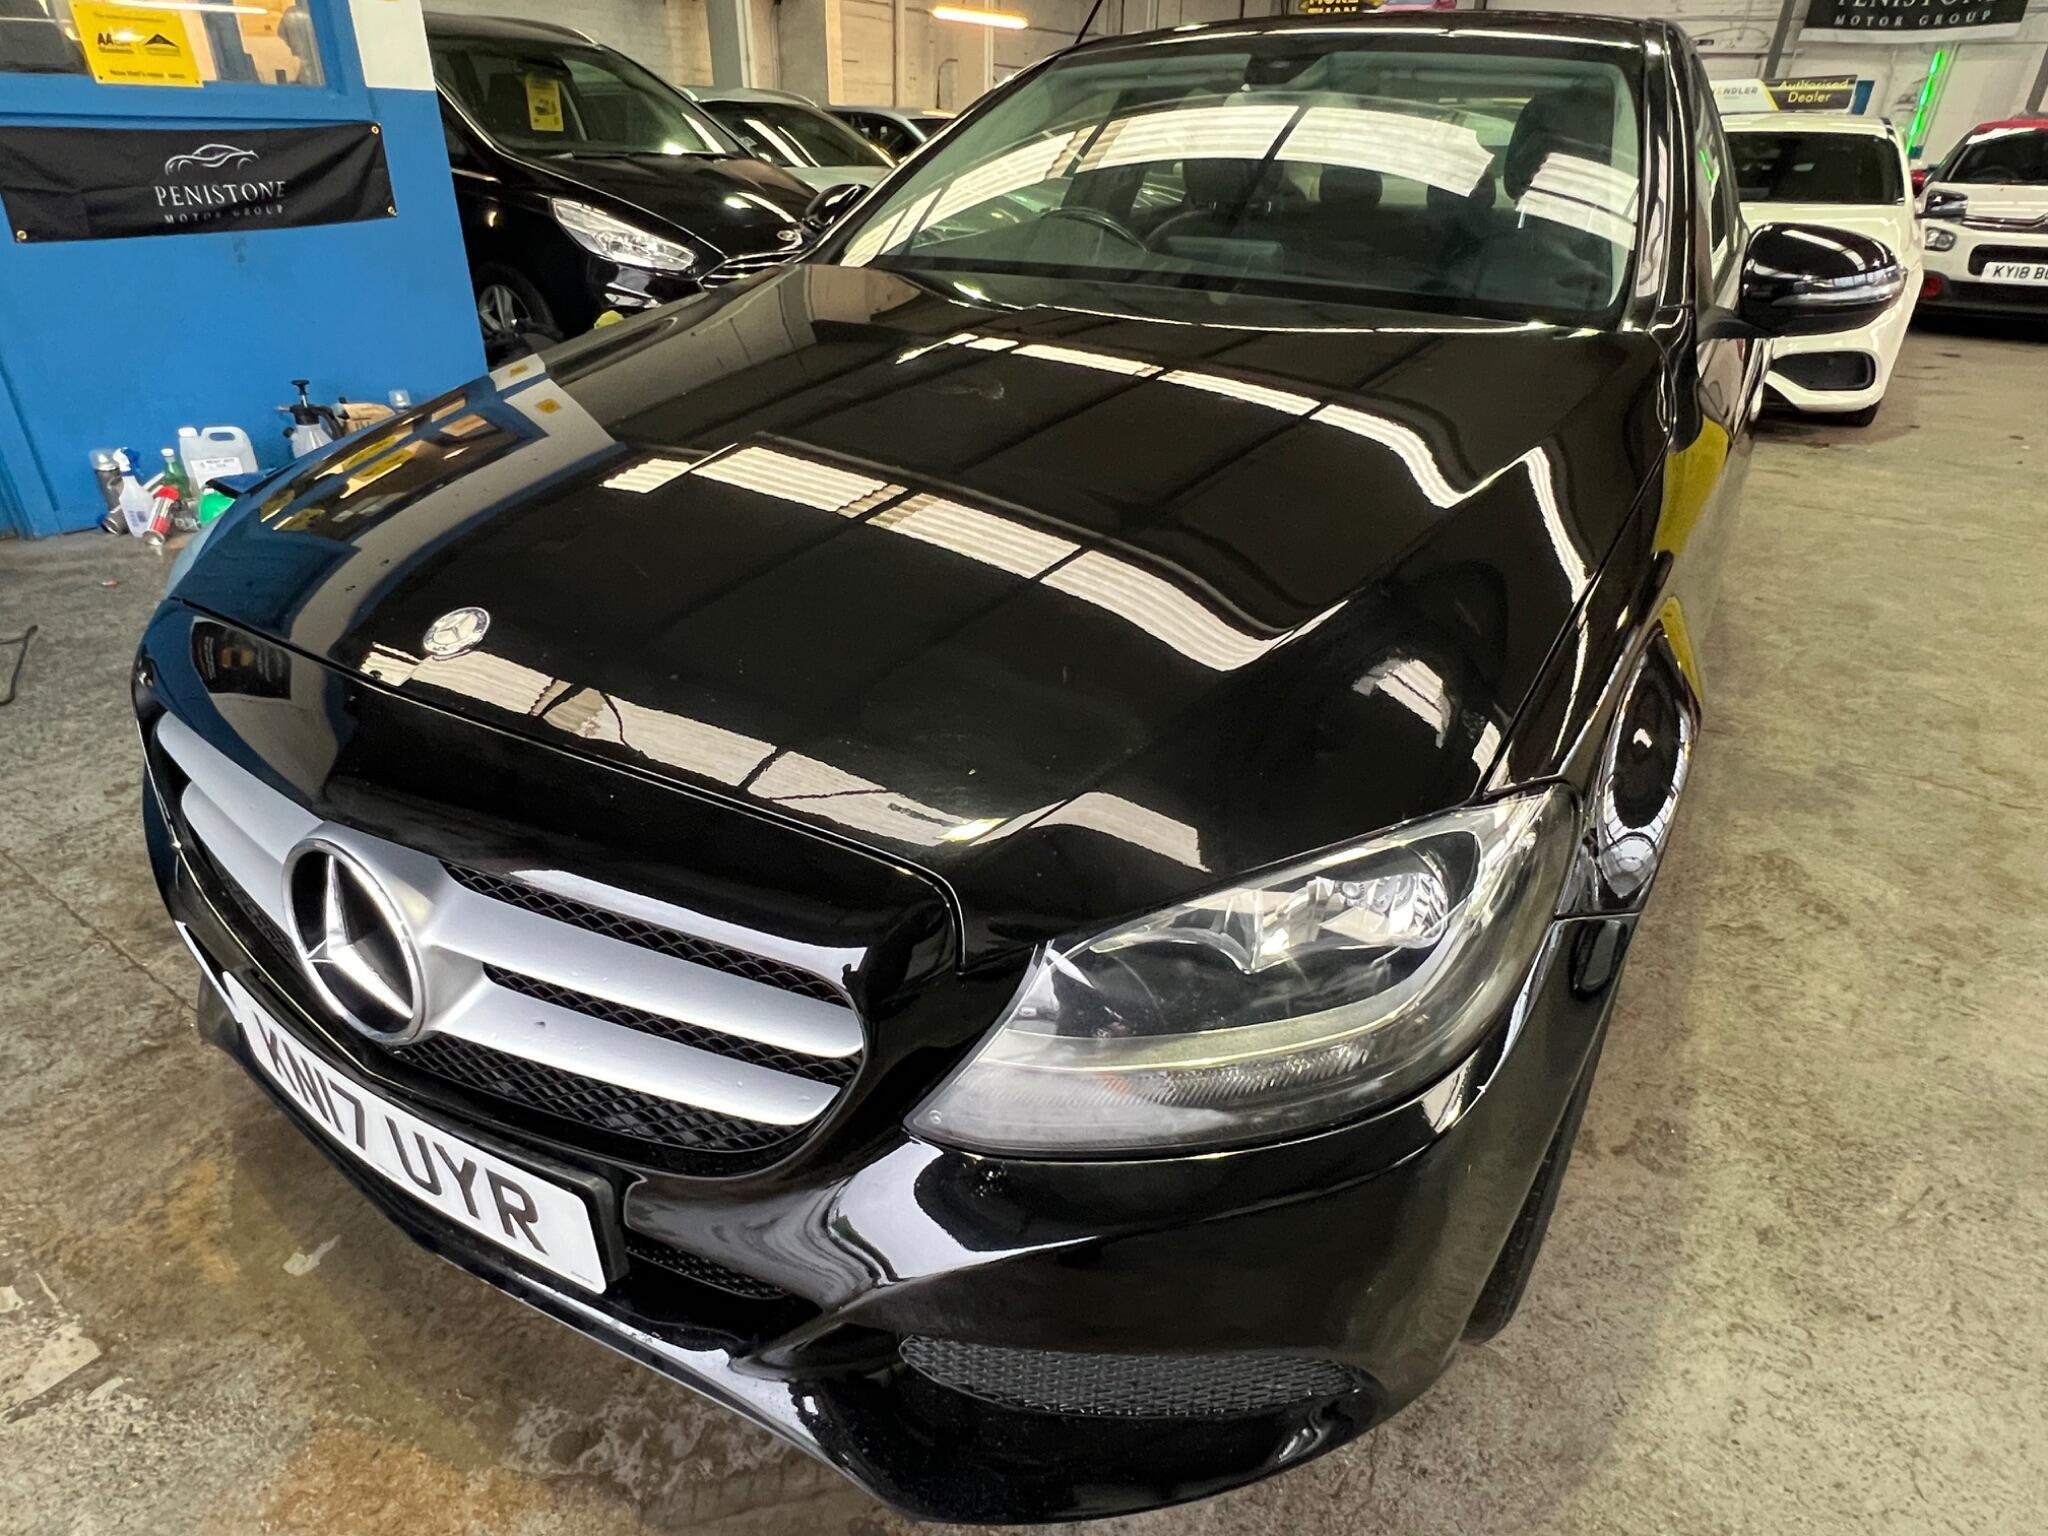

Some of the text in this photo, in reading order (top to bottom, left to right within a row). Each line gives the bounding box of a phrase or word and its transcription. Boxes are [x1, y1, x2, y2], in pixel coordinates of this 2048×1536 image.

[1834, 9, 1992, 27] MOTOR GROUP
[1777, 78, 1850, 90] Authorised
[1787, 91, 1832, 103] Dealer
[154, 181, 286, 206] PENISTONE
[1992, 265, 2030, 279] KY18
[385, 1115, 549, 1256] UYR
